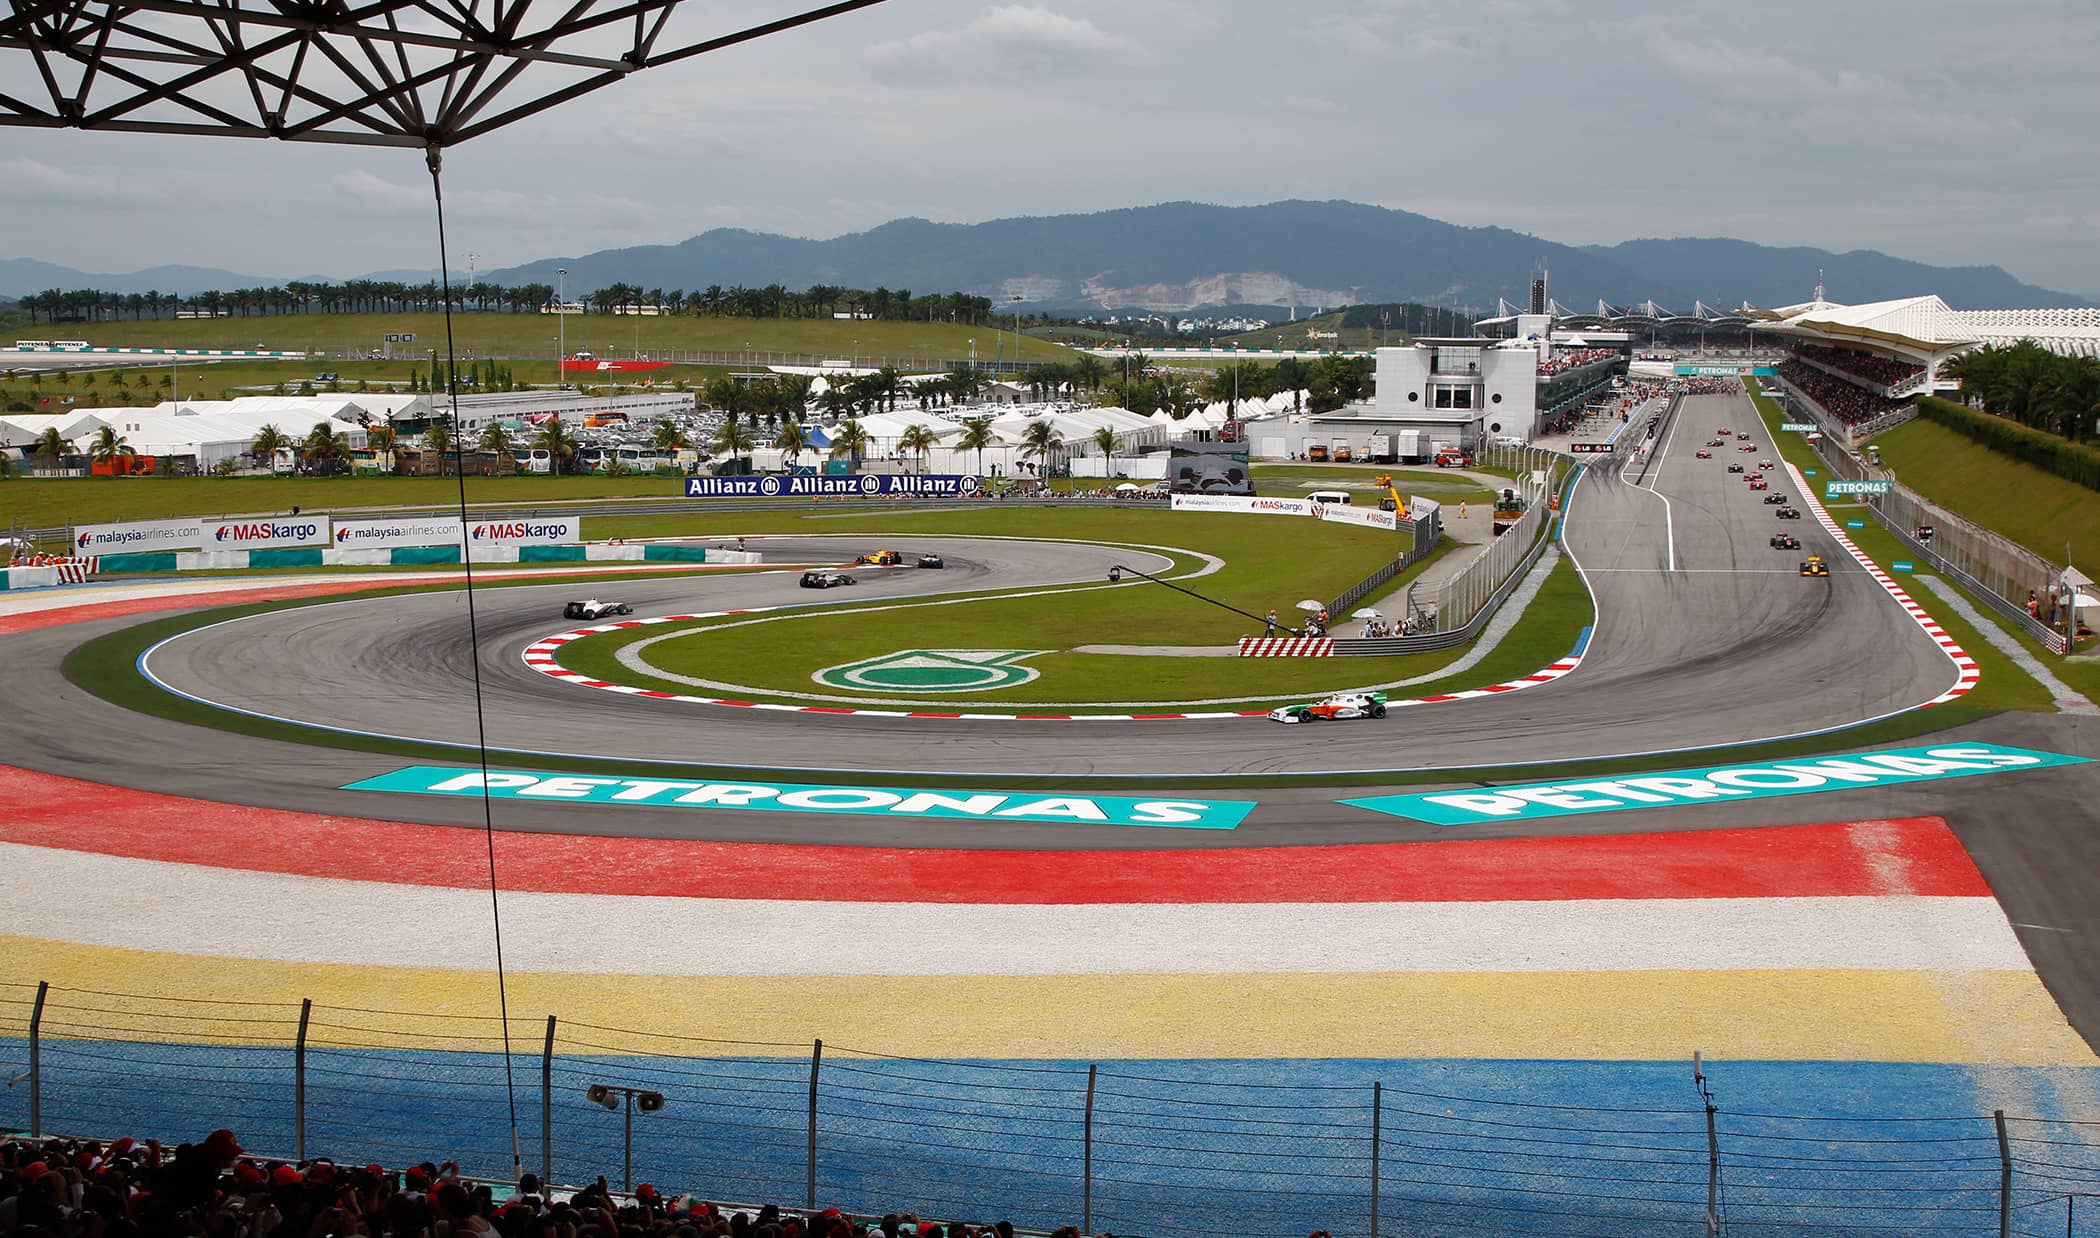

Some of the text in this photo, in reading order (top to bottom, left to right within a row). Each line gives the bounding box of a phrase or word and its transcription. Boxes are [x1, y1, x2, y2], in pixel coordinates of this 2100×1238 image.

[1699, 367, 1737, 375] PETRONAS
[689, 476, 956, 494] Allianz Allianz Allianz
[1829, 483, 1887, 493] PETRONAS
[1260, 501, 1303, 512] MASkargo
[96, 526, 200, 548] malaysiaairlines.com
[233, 522, 317, 541] MASkargo
[355, 523, 459, 543] malaysiaairlines.com
[489, 522, 568, 540] MASkargo
[1420, 748, 2042, 816] PETRONAS
[426, 772, 1211, 823] PETRONAS
